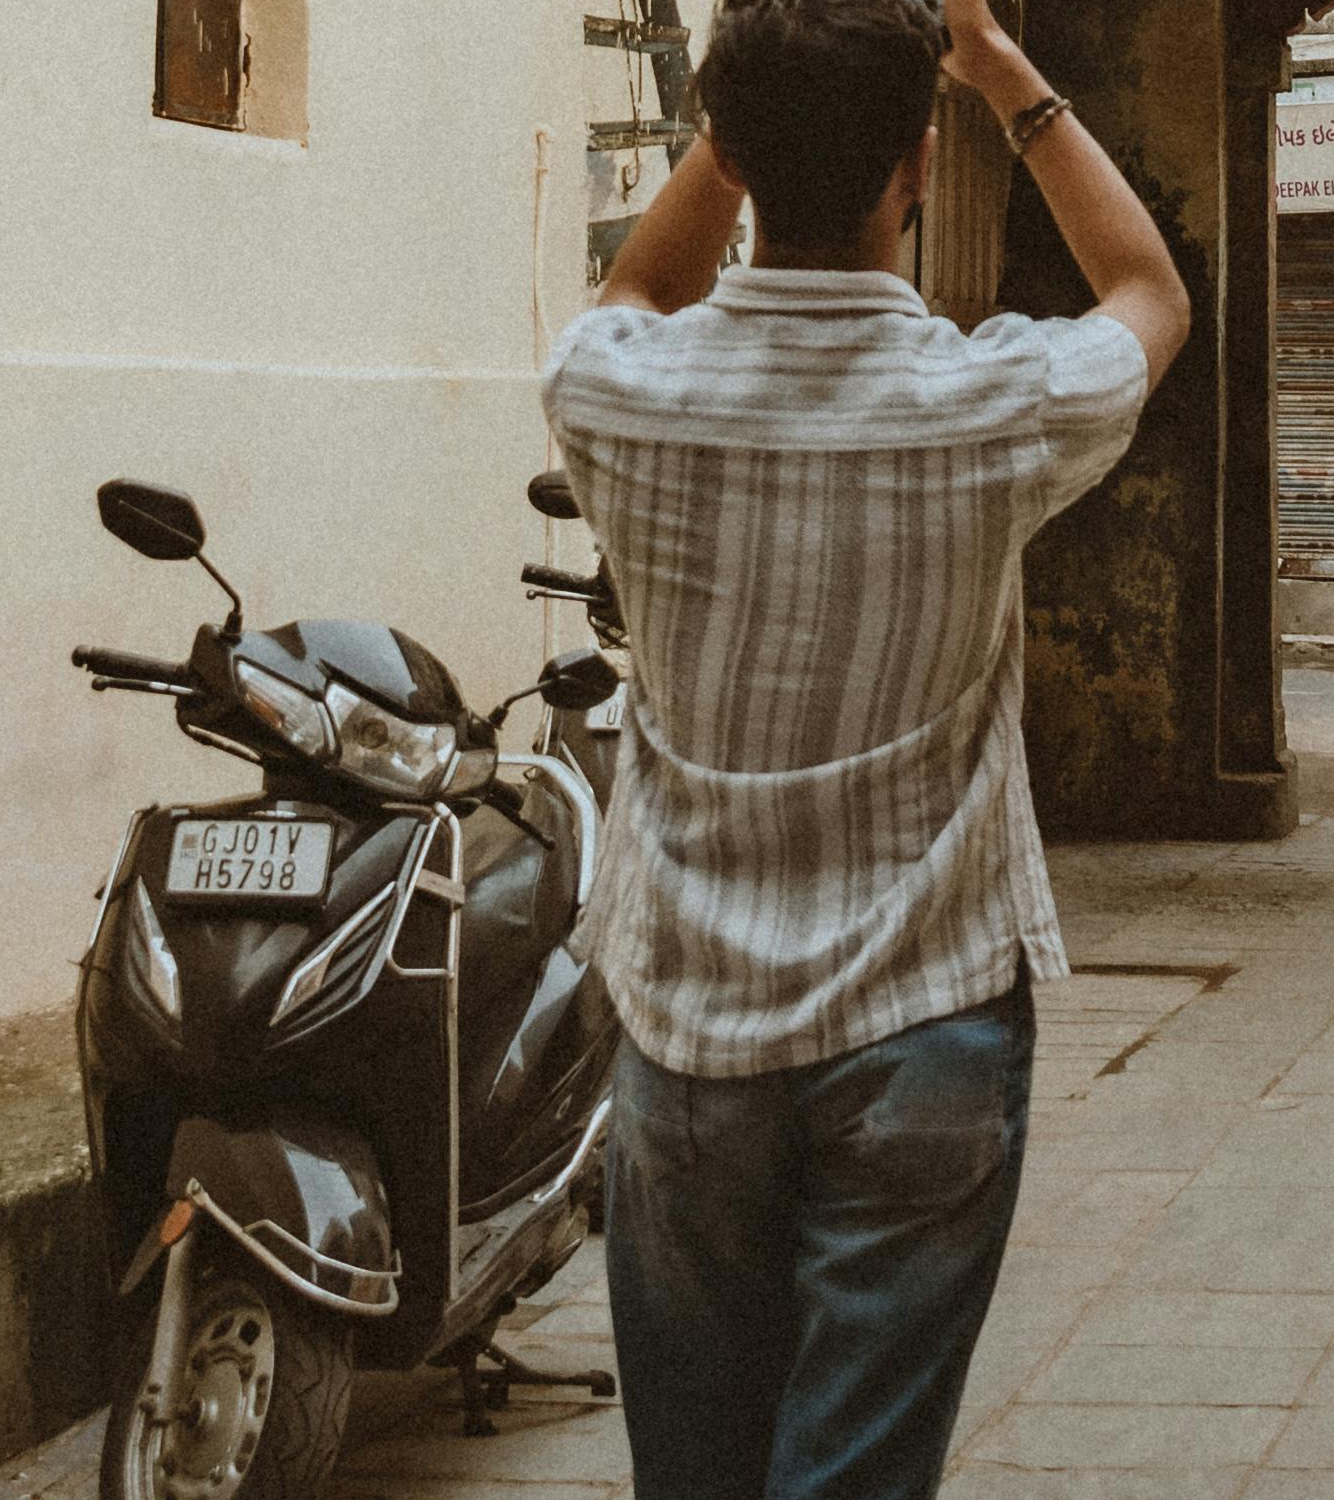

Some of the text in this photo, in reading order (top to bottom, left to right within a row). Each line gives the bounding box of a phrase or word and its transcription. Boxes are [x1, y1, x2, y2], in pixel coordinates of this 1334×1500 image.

[1275, 124, 1306, 147] ીપક
[202, 823, 302, 855] GJ01V
[194, 858, 297, 891] H5798
